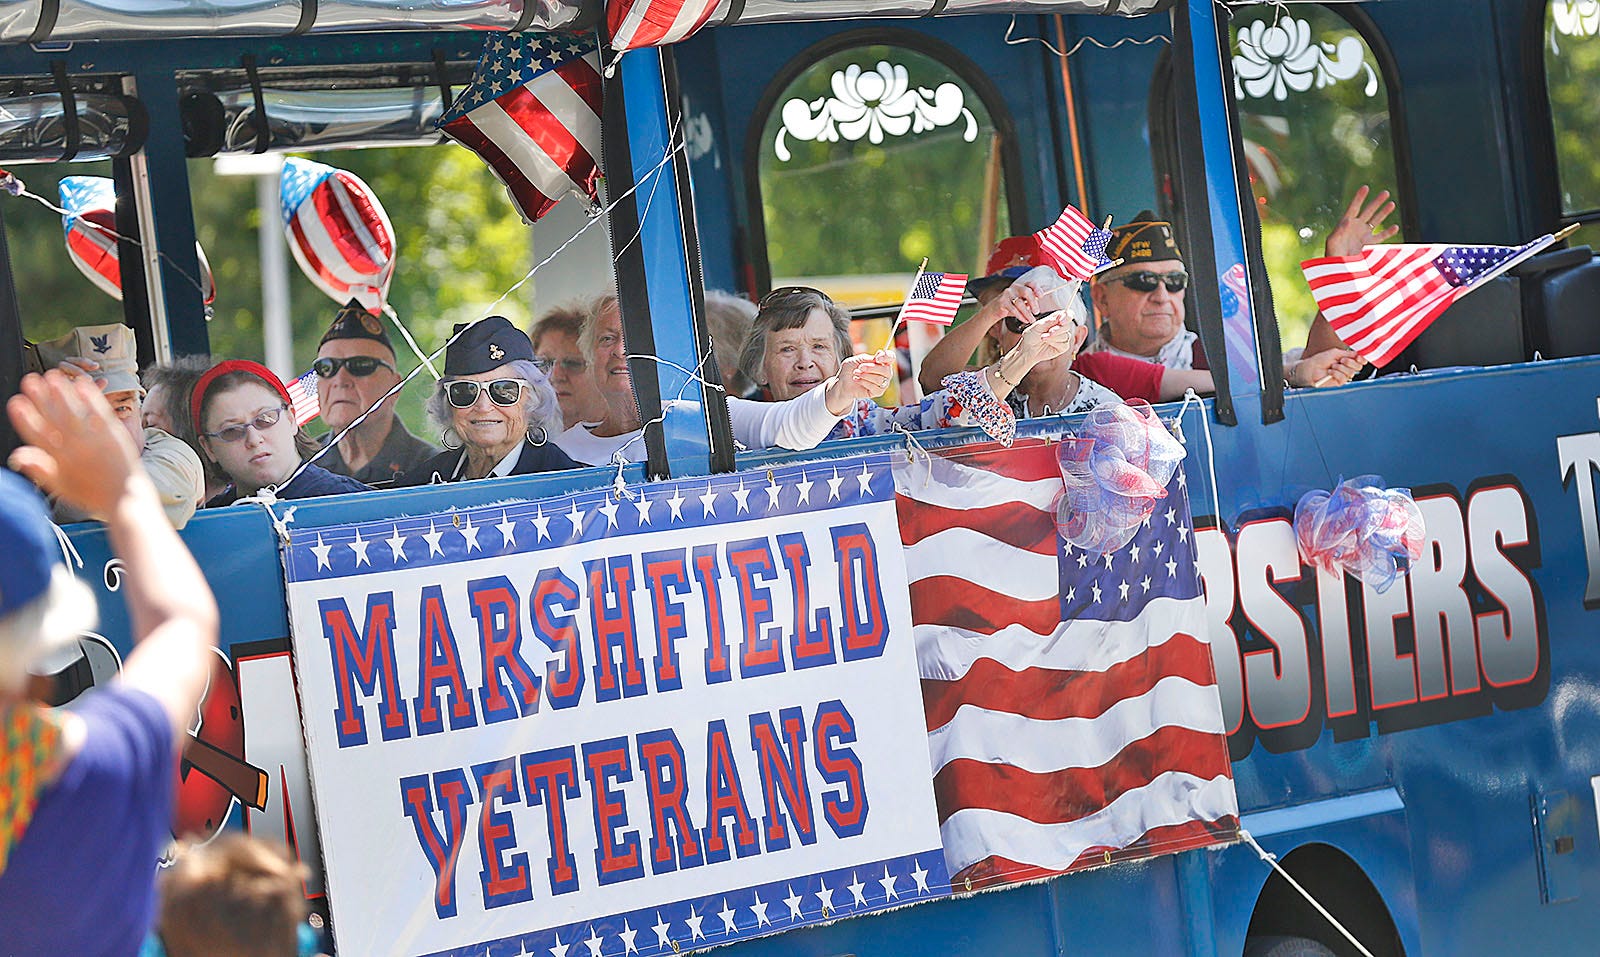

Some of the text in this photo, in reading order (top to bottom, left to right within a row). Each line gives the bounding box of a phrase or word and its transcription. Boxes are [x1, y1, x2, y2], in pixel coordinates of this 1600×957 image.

[1132, 241, 1151, 249] VFW
[318, 523, 889, 748] MARSHFIELD
[400, 700, 869, 919] VETERANS
